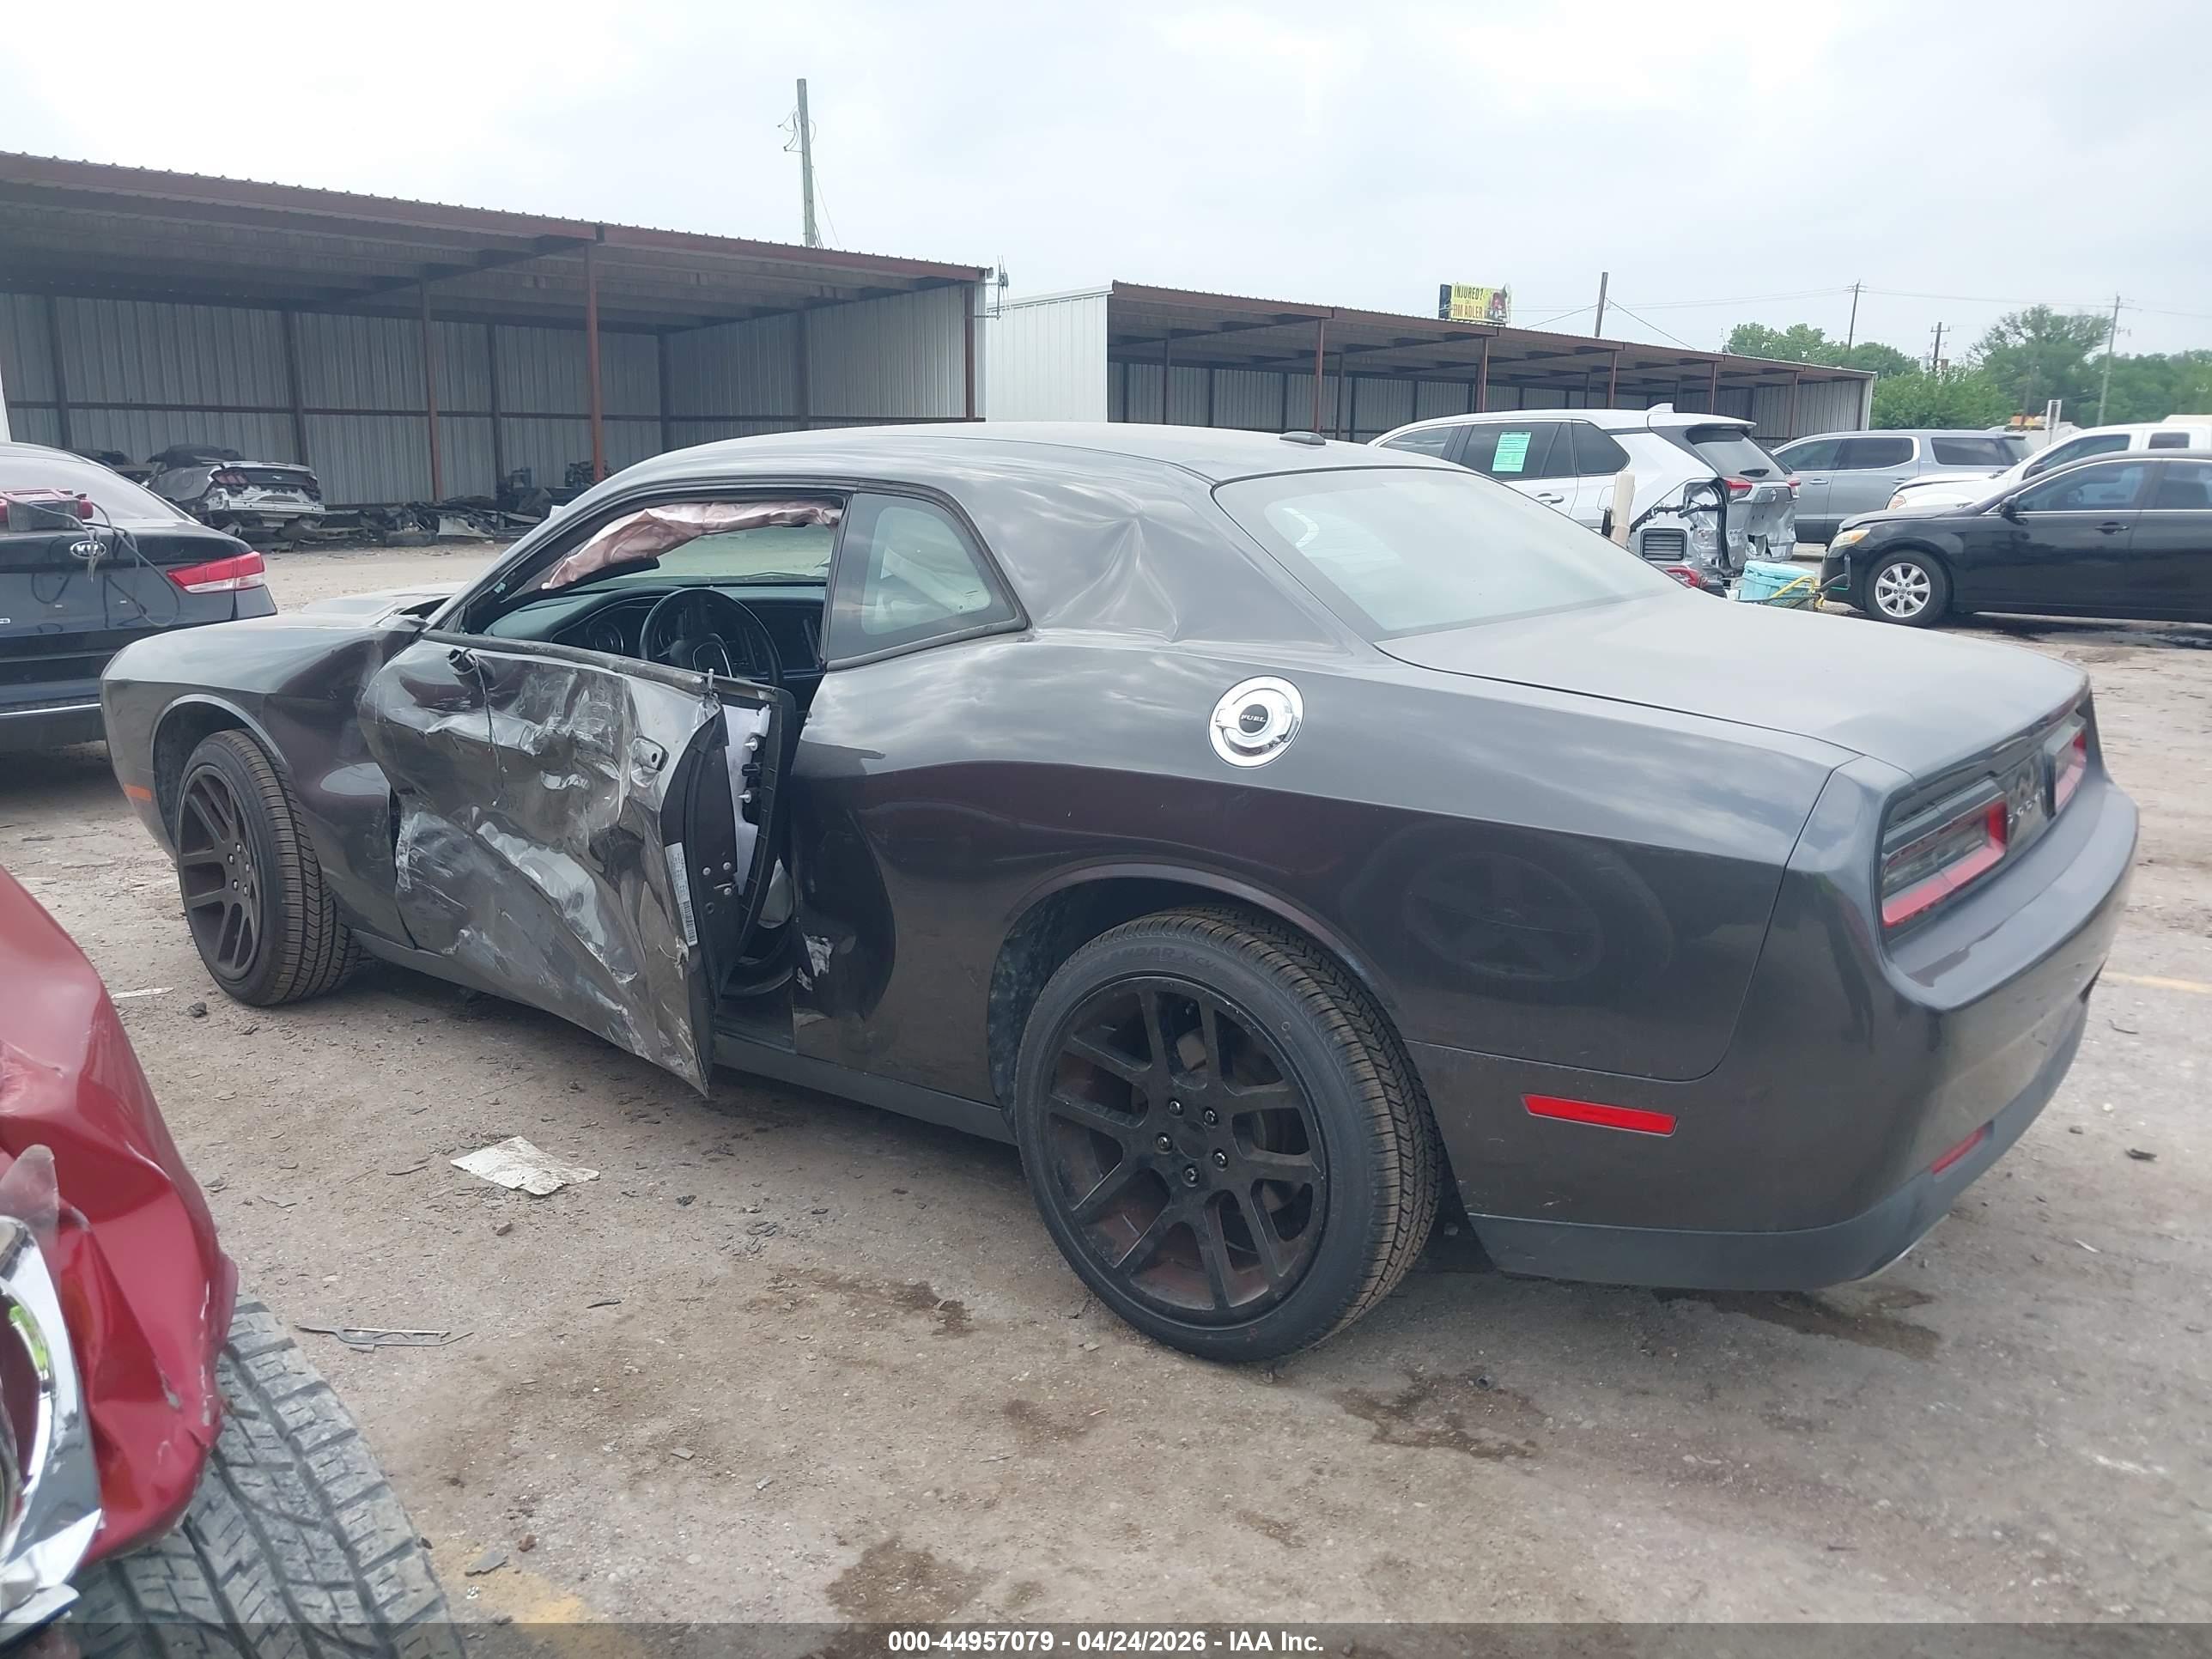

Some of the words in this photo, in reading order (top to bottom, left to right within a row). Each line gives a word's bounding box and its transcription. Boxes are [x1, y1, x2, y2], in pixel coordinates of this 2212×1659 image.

[1454, 285, 1484, 301] INJURED?
[1452, 304, 1463, 317] JIM
[1465, 305, 1483, 319] ADLER
